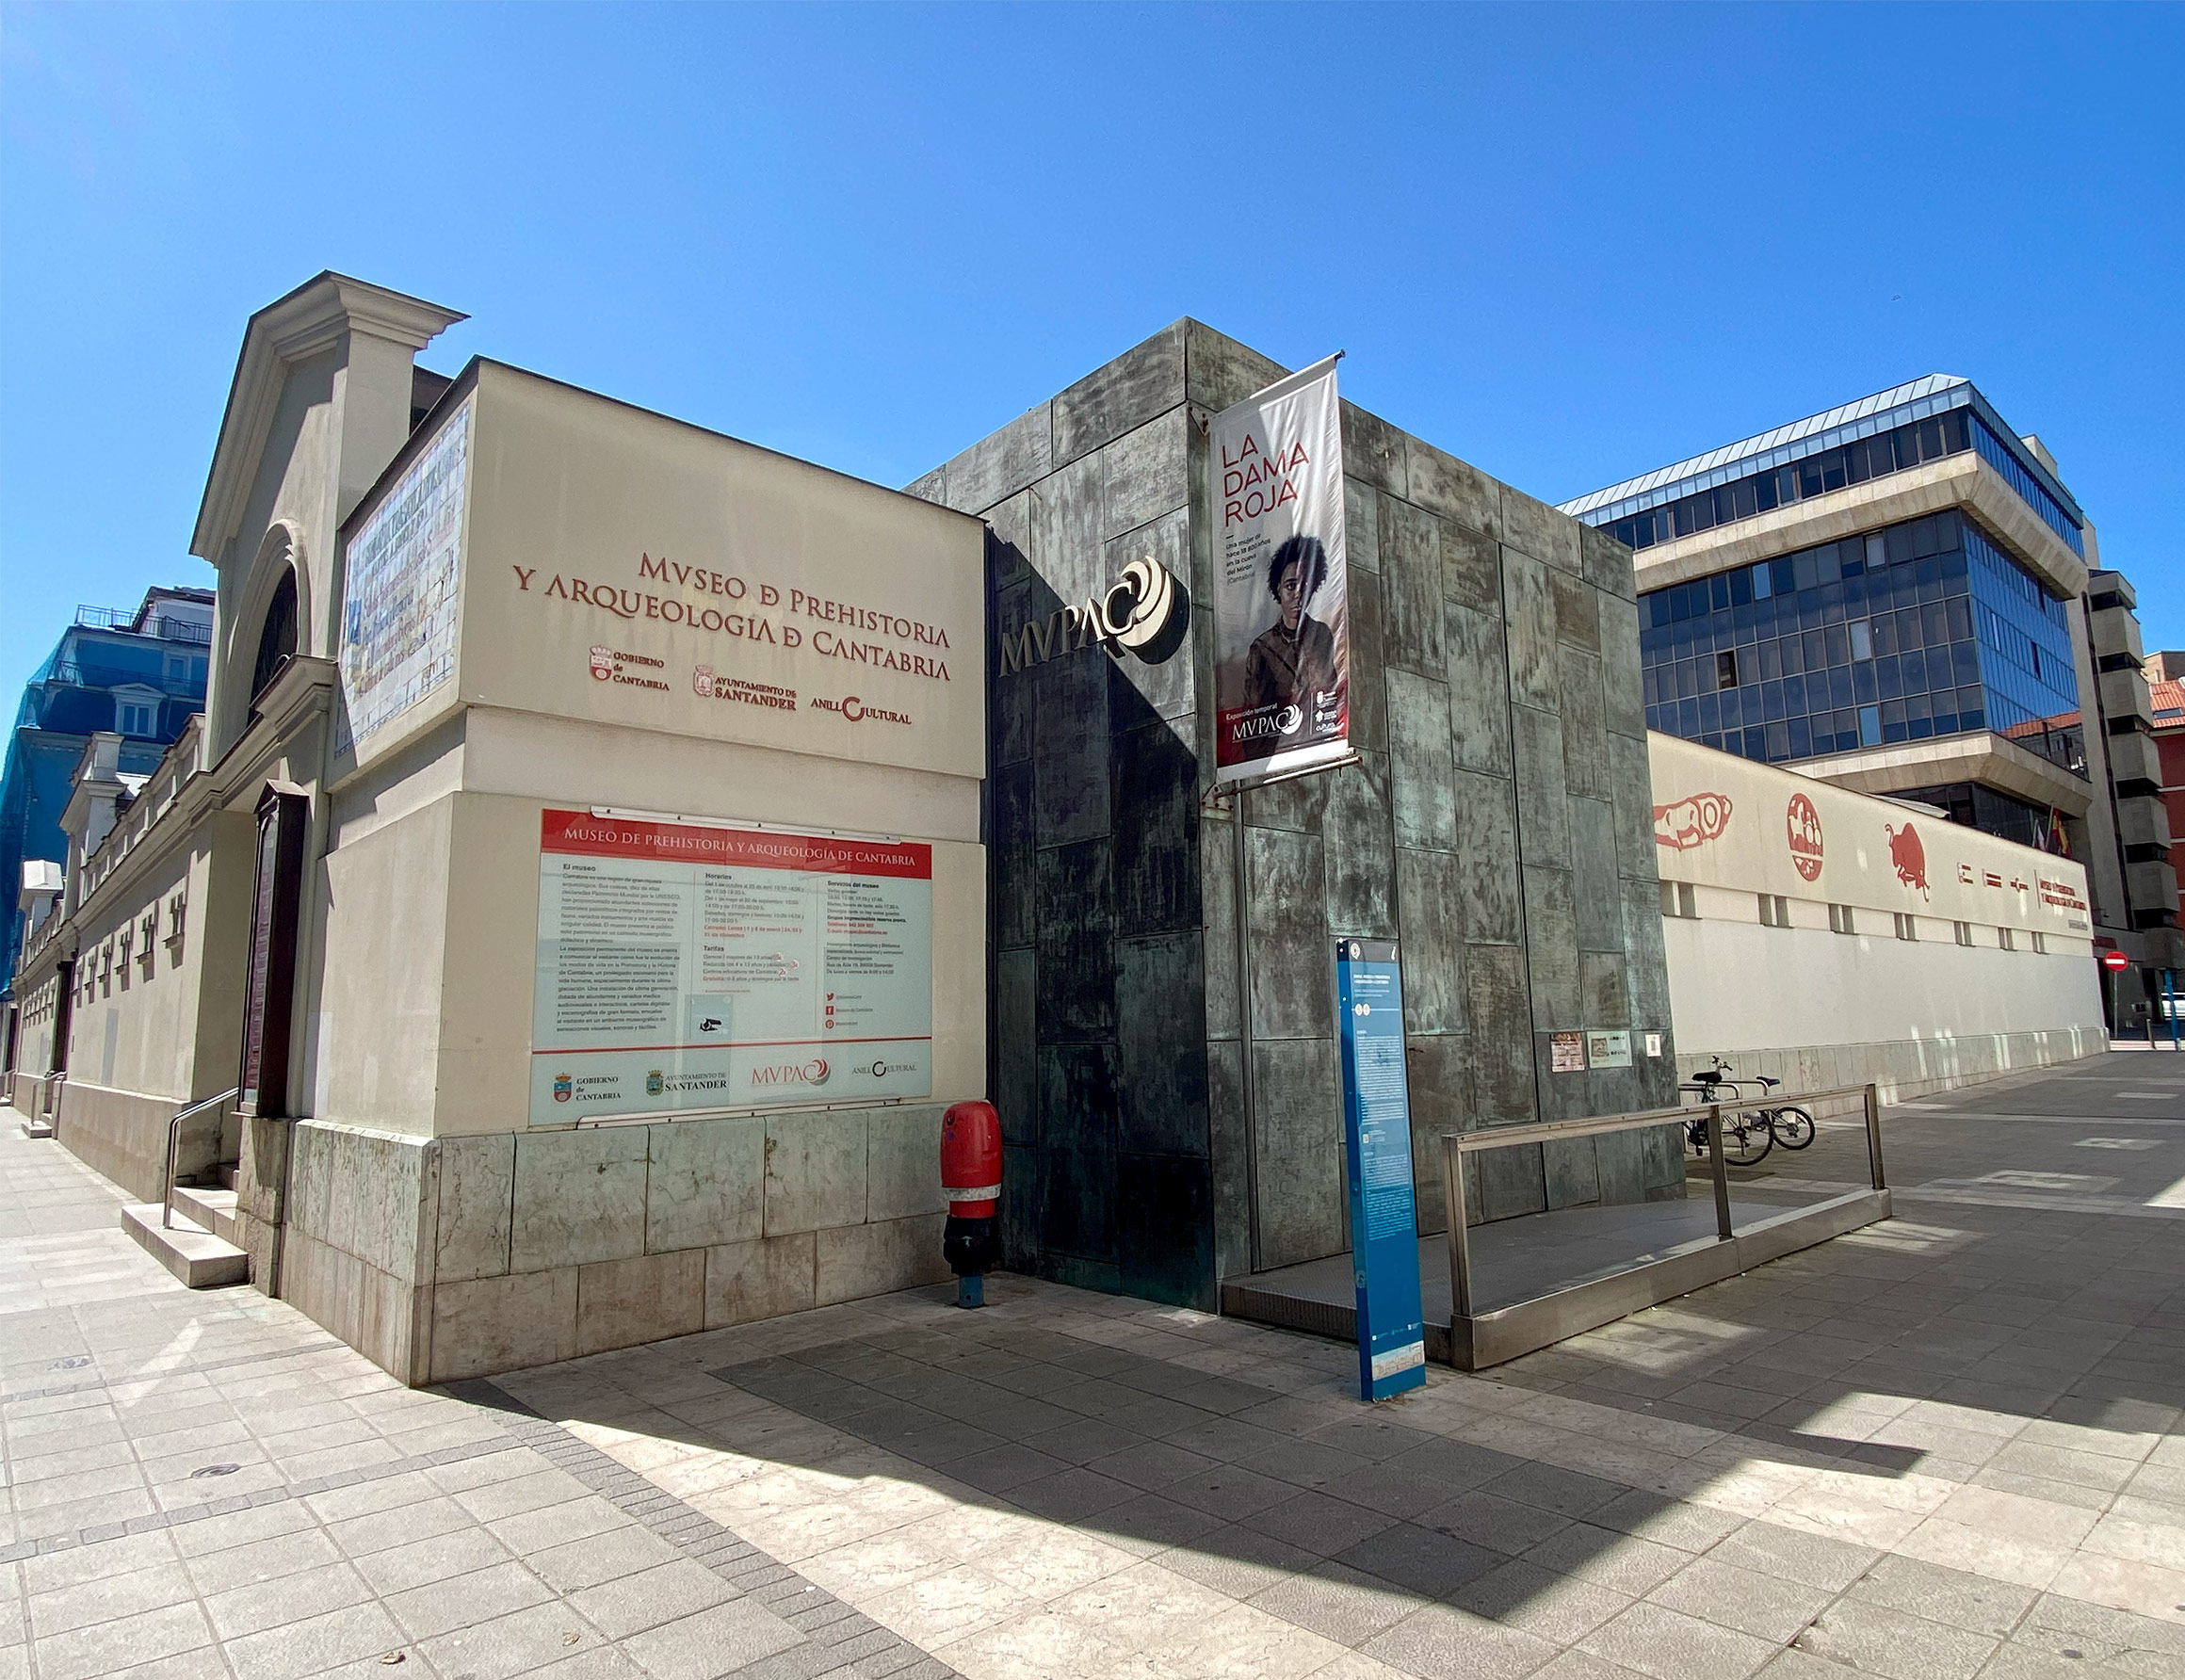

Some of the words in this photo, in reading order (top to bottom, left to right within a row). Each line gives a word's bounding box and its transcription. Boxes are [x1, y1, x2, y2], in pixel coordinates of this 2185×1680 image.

[1222, 434, 1258, 468] LA
[1224, 442, 1309, 498] DAMA
[1225, 478, 1298, 527] ROJA
[513, 565, 537, 590] Y
[544, 573, 776, 644] ARQUEOLOGIA
[813, 631, 950, 681] CANTABRIA
[790, 589, 950, 648] PREHISTORIA
[998, 576, 1140, 678] MVPAC
[613, 652, 665, 669] GOBIERNO
[613, 664, 623, 672] de
[613, 674, 670, 691] CANTABRIA
[715, 676, 785, 697] AYUNTAMIENTO
[785, 689, 797, 699] DE
[715, 687, 797, 711] SANTANDER
[1232, 711, 1290, 740] MVPAC
[564, 828, 617, 843] MUSEO
[622, 832, 640, 845] DE
[645, 834, 733, 851] PREHISTORIA
[736, 842, 746, 853] Y
[748, 843, 835, 860] ARQUEOLOGÍA
[838, 850, 853, 862] DE
[855, 852, 915, 866] CANTABRIA
[576, 1076, 619, 1085] GOBIERNO
[665, 1073, 718, 1082] AYUNTAMIENTO
[752, 1062, 817, 1085] MVPAC
[575, 1092, 622, 1102] CANTABRIA
[665, 1080, 727, 1092] SANTANDER
